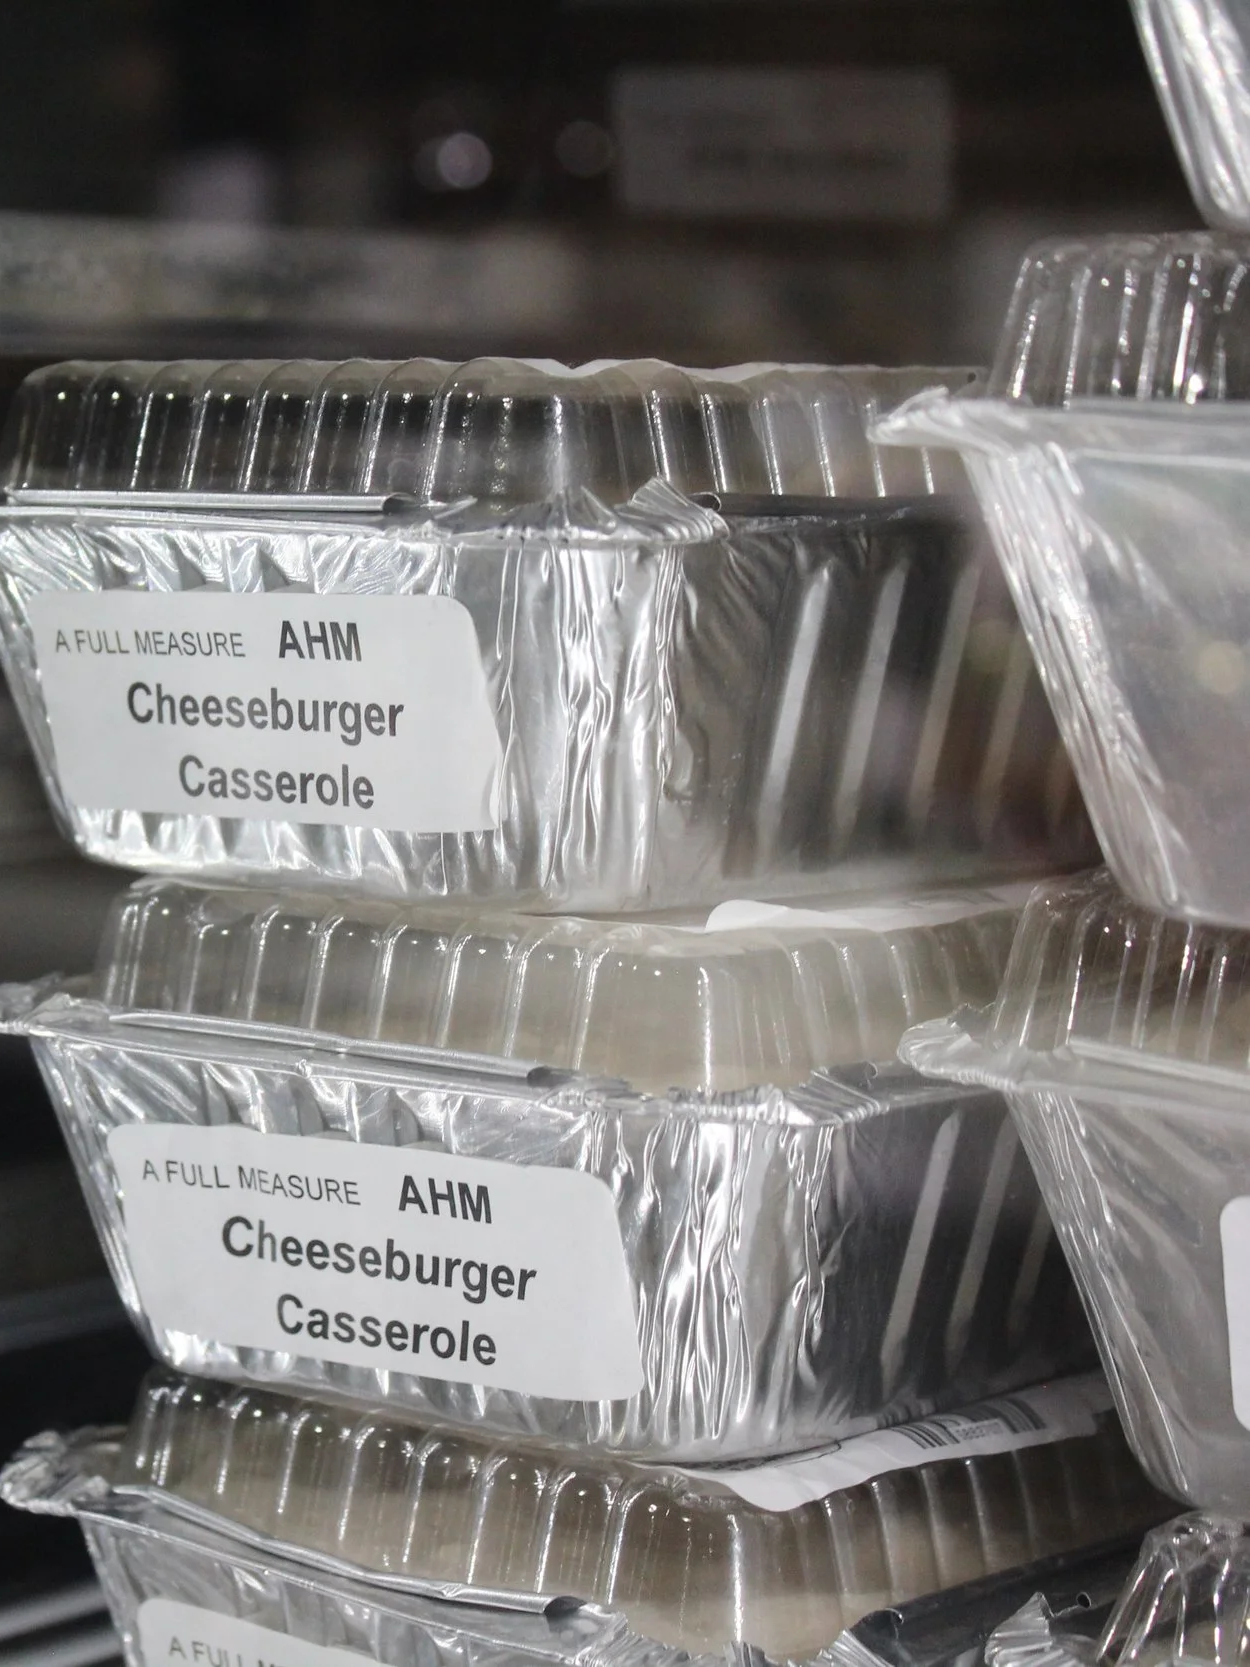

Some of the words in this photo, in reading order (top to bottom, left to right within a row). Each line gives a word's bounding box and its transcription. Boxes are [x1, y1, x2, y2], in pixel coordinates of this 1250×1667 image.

[55, 630, 71, 653] A
[76, 630, 129, 655] FULL
[135, 630, 246, 658] MEASURE
[279, 620, 363, 662] AHM
[127, 681, 404, 746] Cheeseburger
[178, 754, 375, 809] Casserole
[142, 1159, 160, 1182] A
[165, 1160, 230, 1189] FULL
[238, 1165, 361, 1206] MEASURE
[398, 1175, 493, 1224] AHM
[222, 1215, 537, 1304] Cheeseburger
[277, 1294, 497, 1366] Casserole
